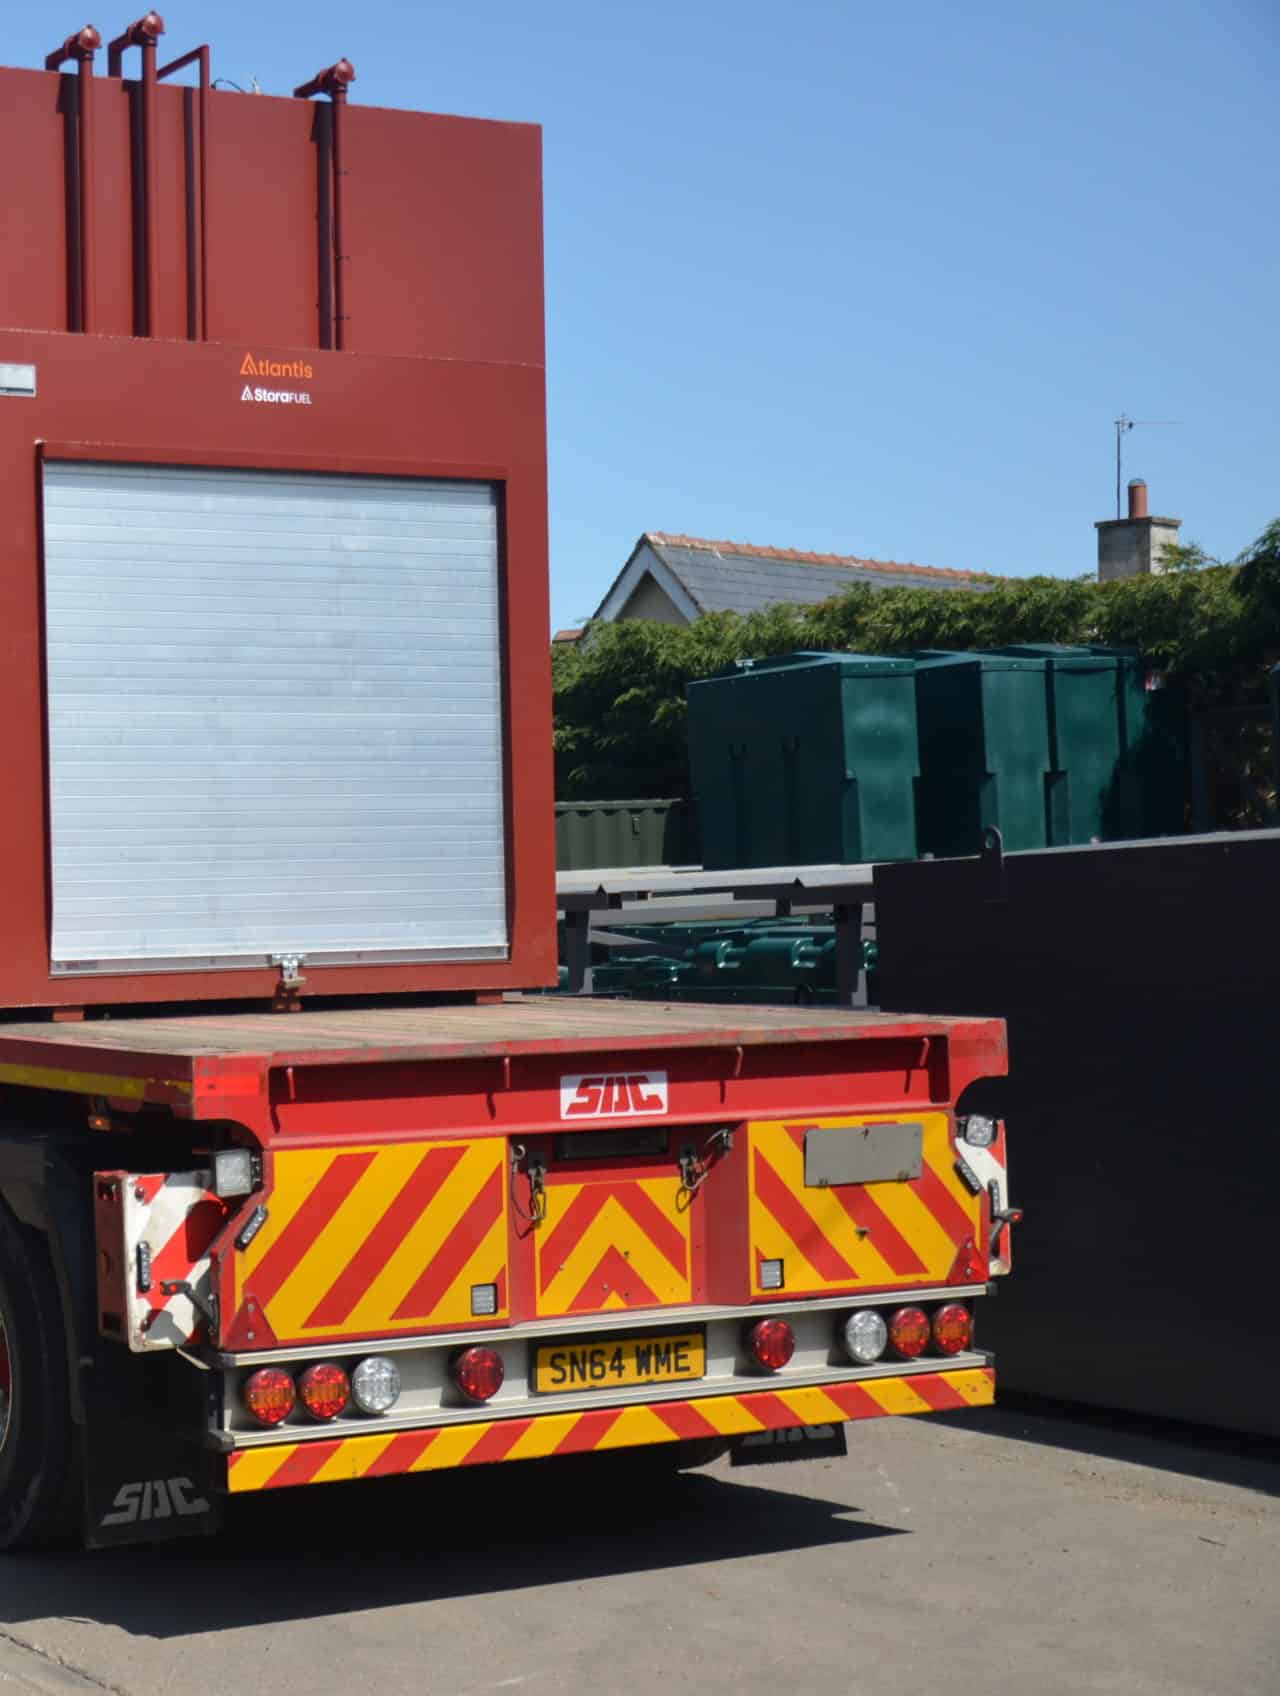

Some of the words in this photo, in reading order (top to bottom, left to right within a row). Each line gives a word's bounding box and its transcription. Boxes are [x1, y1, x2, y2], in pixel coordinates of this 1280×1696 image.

[240, 352, 312, 378] Atlantis
[549, 1349, 625, 1385] SN64
[635, 1341, 691, 1376] WME
